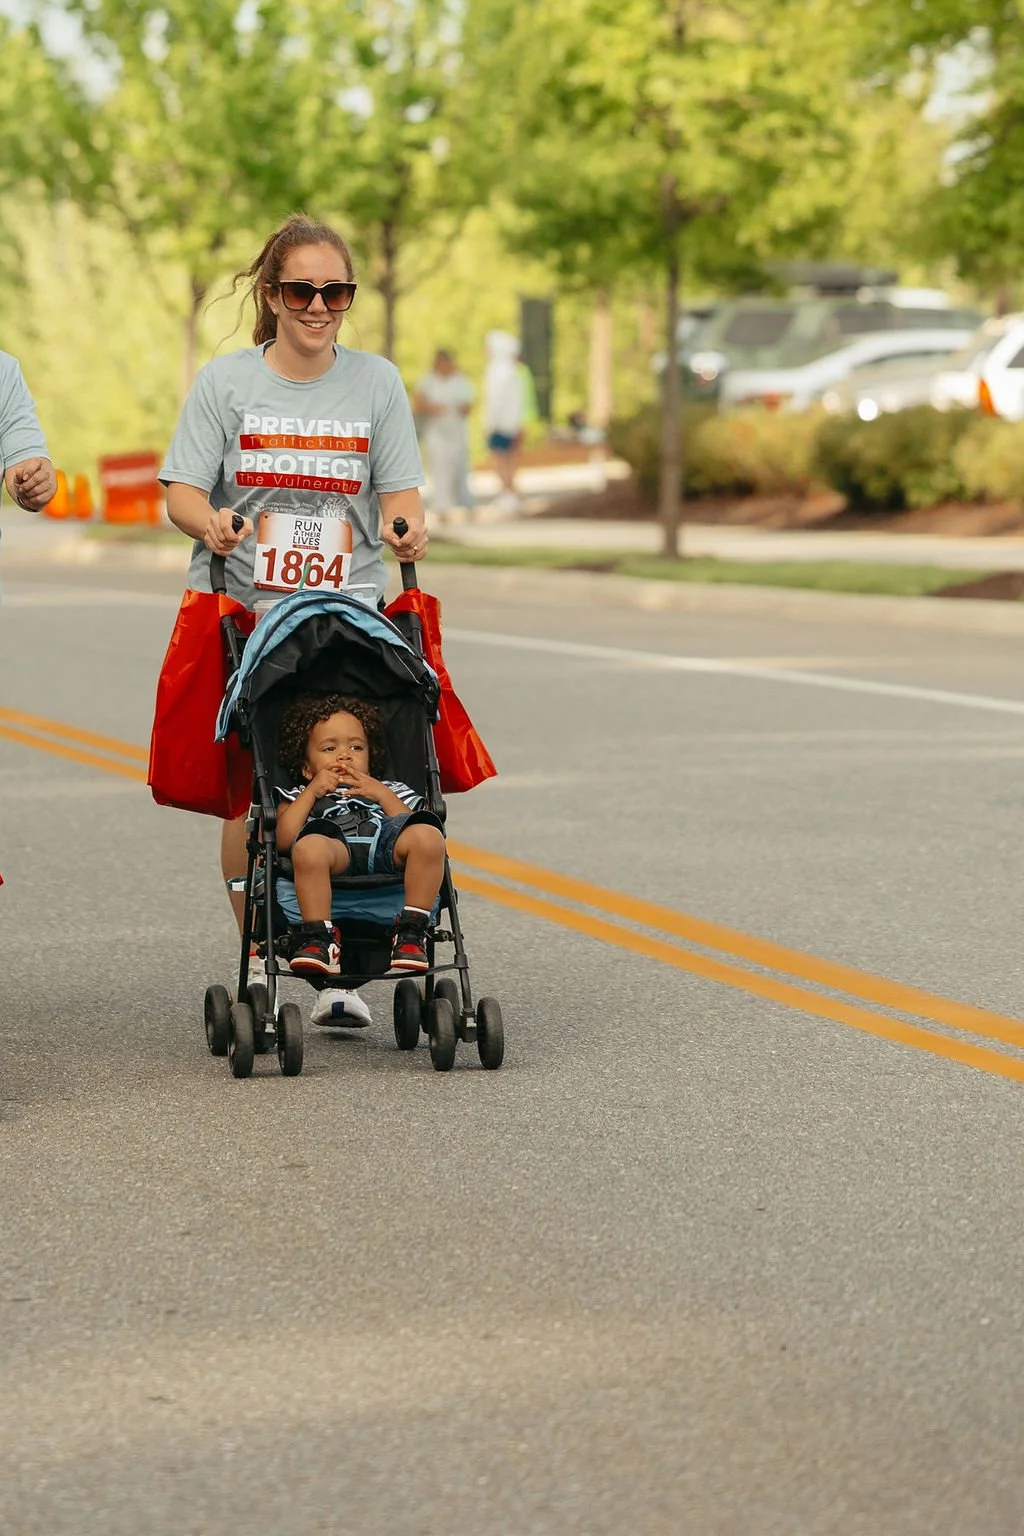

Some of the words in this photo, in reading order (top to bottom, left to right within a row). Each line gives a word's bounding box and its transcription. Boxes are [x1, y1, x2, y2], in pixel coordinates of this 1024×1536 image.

[243, 413, 371, 438] PREVENT
[249, 435, 357, 451] Trafficking
[240, 452, 362, 480] PROTECT
[239, 472, 264, 485] The
[273, 474, 359, 493] Vulnerable
[294, 520, 322, 532] RUN
[301, 530, 321, 538] THEIR
[292, 536, 320, 546] LIVES
[262, 547, 344, 589] 1864
